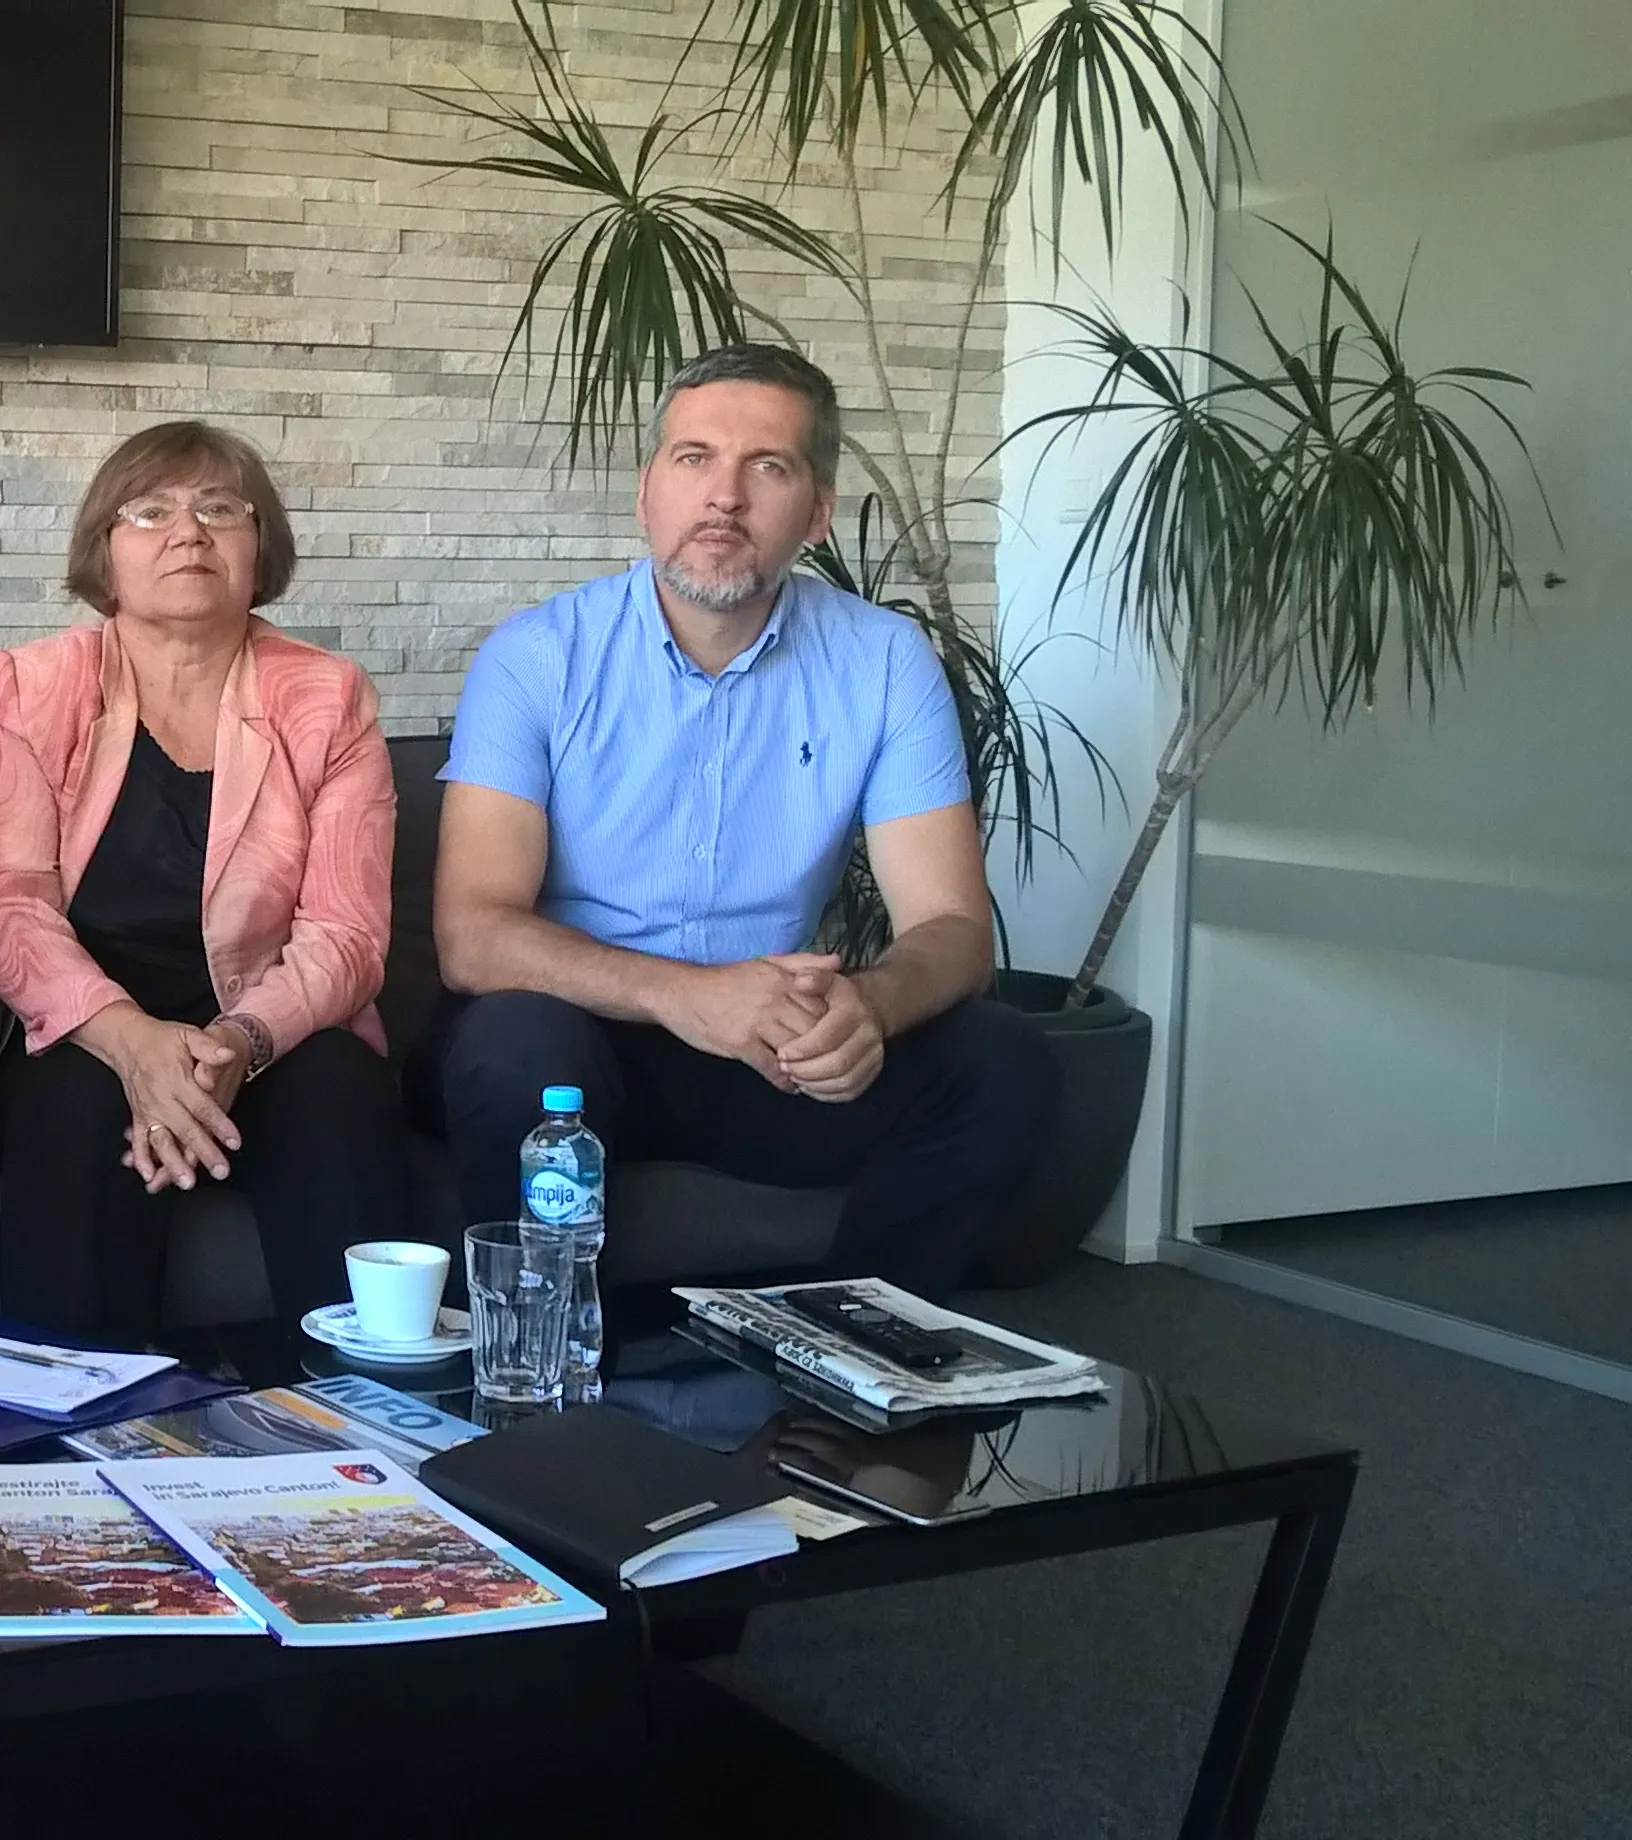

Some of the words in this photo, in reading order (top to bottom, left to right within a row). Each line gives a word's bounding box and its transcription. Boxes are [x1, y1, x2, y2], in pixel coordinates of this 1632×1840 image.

[525, 1183, 575, 1206] mpija
[309, 1379, 444, 1430] INFO
[142, 1480, 205, 1492] Invest
[151, 1491, 174, 1501] in
[175, 1486, 262, 1499] Sarajevo
[263, 1480, 342, 1494] Canton!
